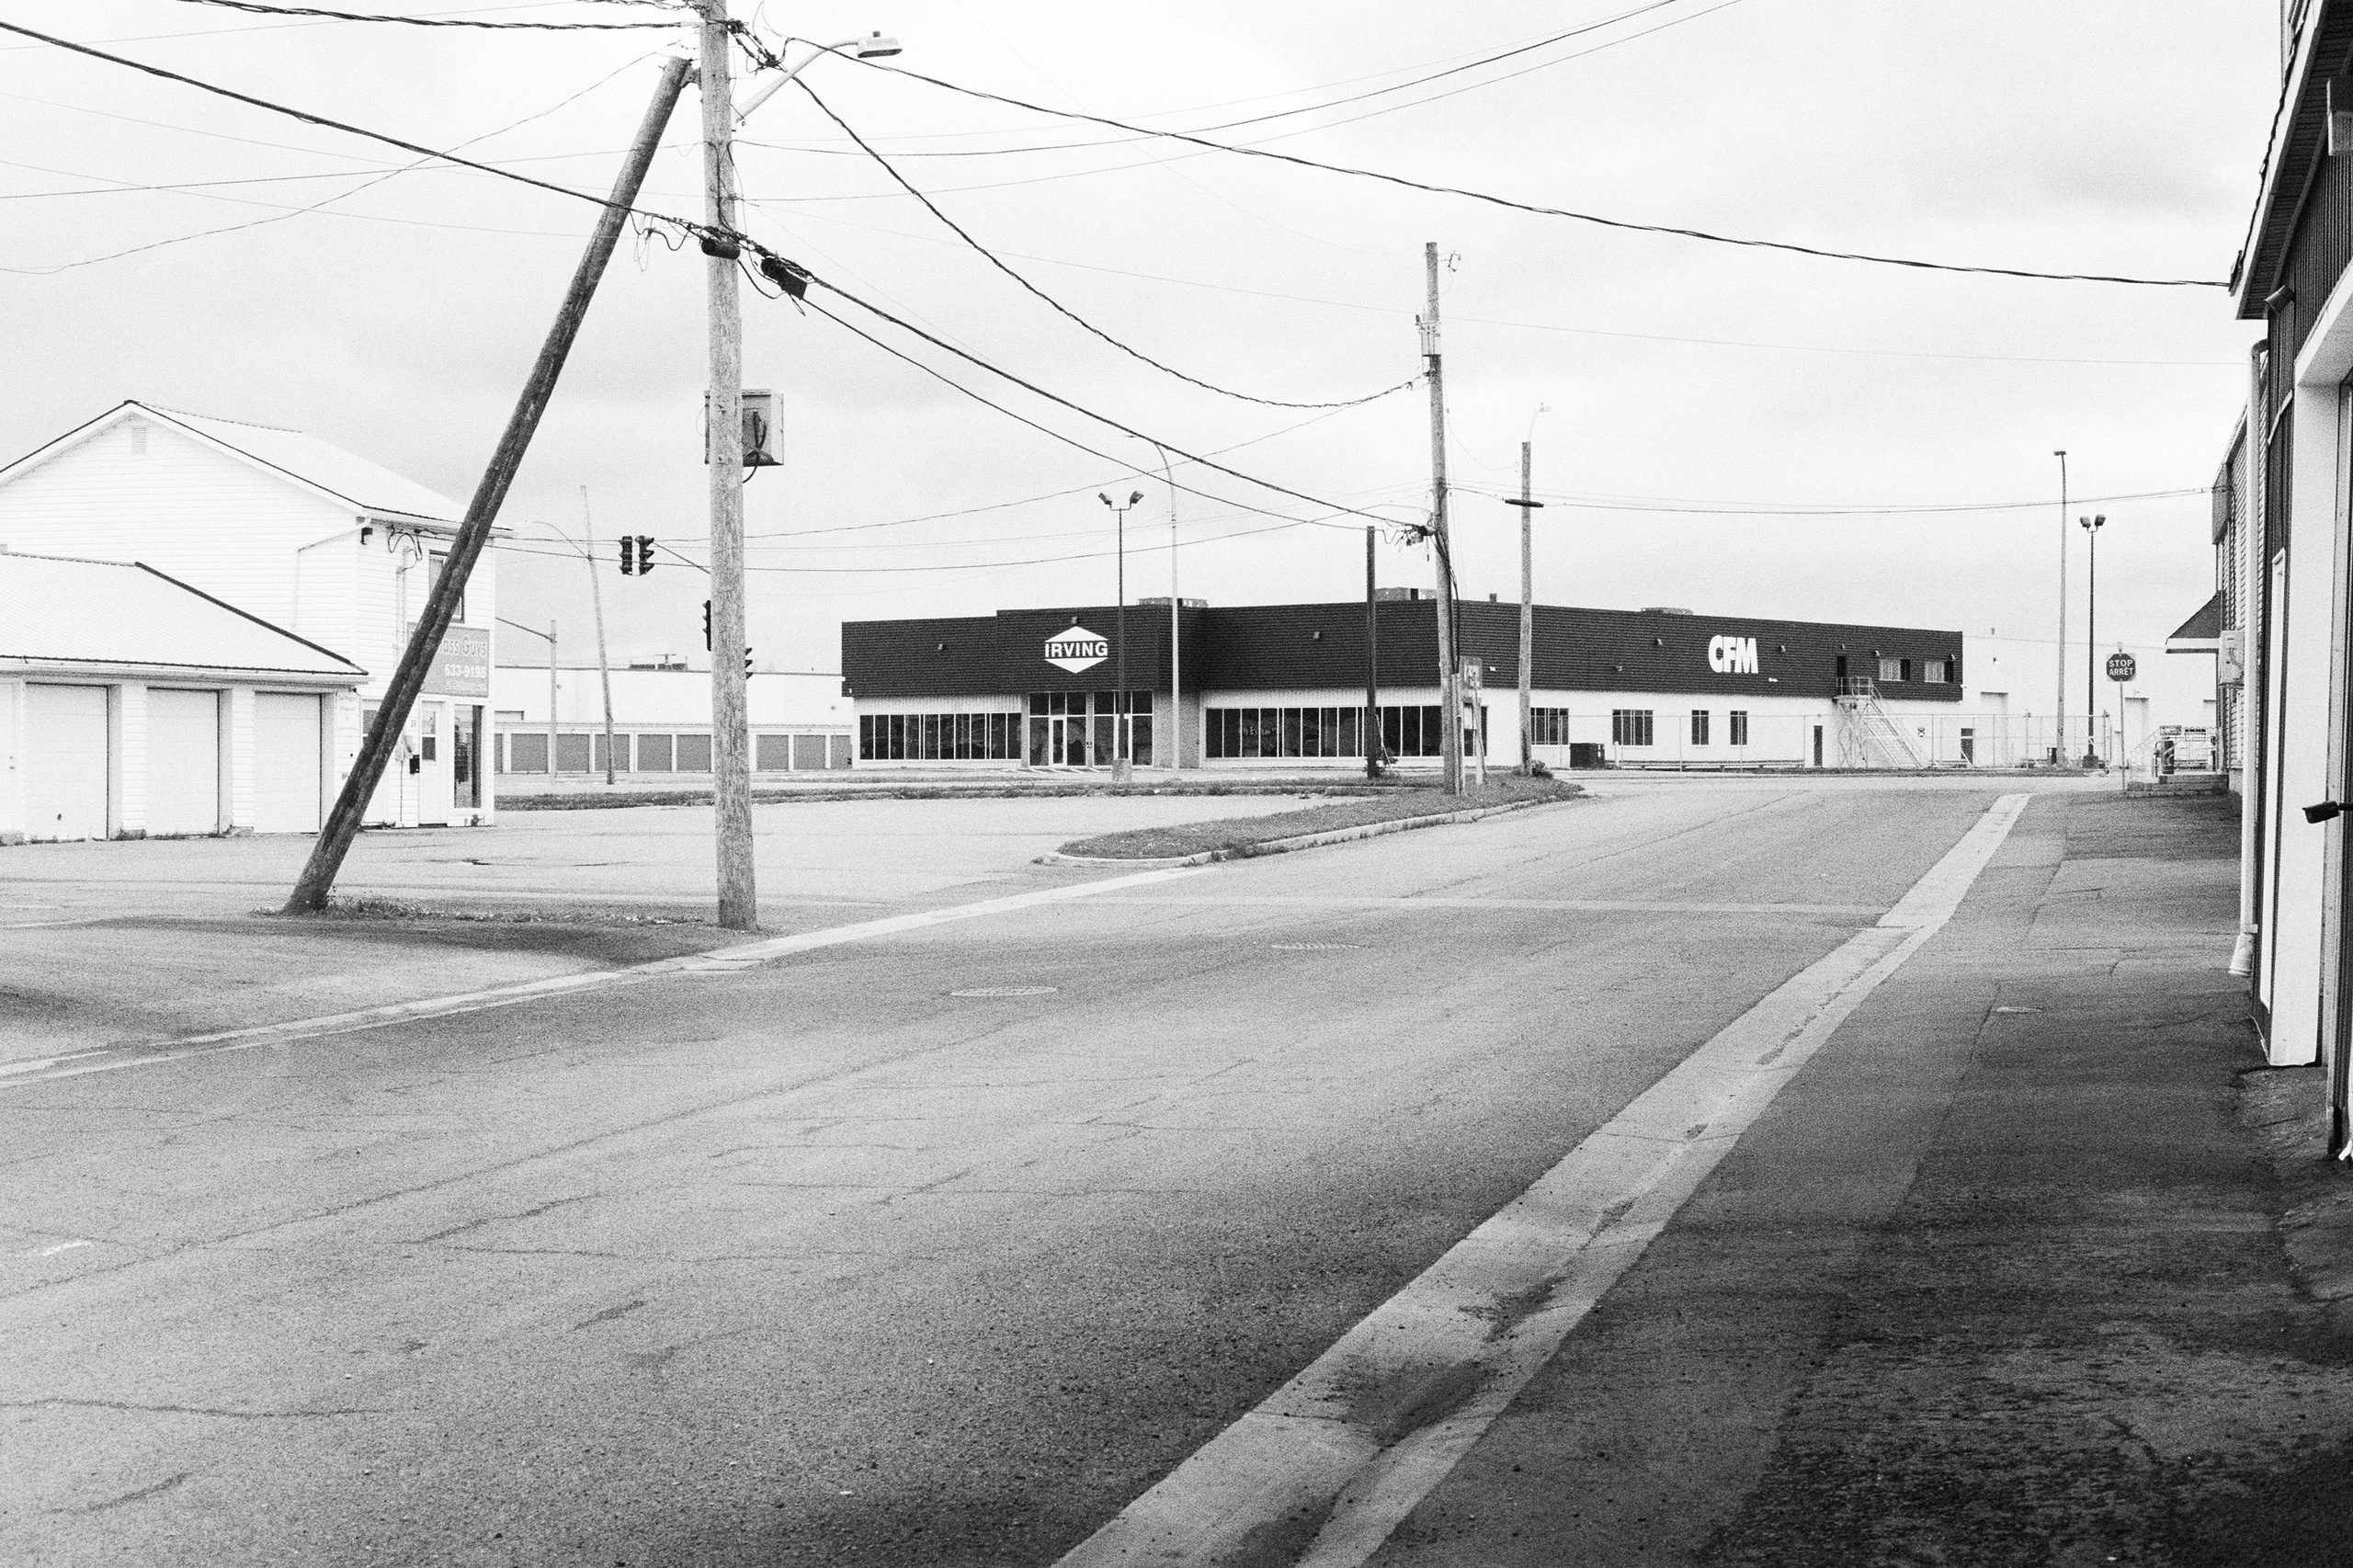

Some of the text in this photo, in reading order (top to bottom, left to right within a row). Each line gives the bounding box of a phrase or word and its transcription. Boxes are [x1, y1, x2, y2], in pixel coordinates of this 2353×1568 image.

[438, 634, 487, 660] lass Guys
[1045, 642, 1108, 657] IRVING
[1709, 635, 1758, 674] CFM
[2109, 659, 2133, 667] STOP
[445, 664, 486, 678] 633-9198
